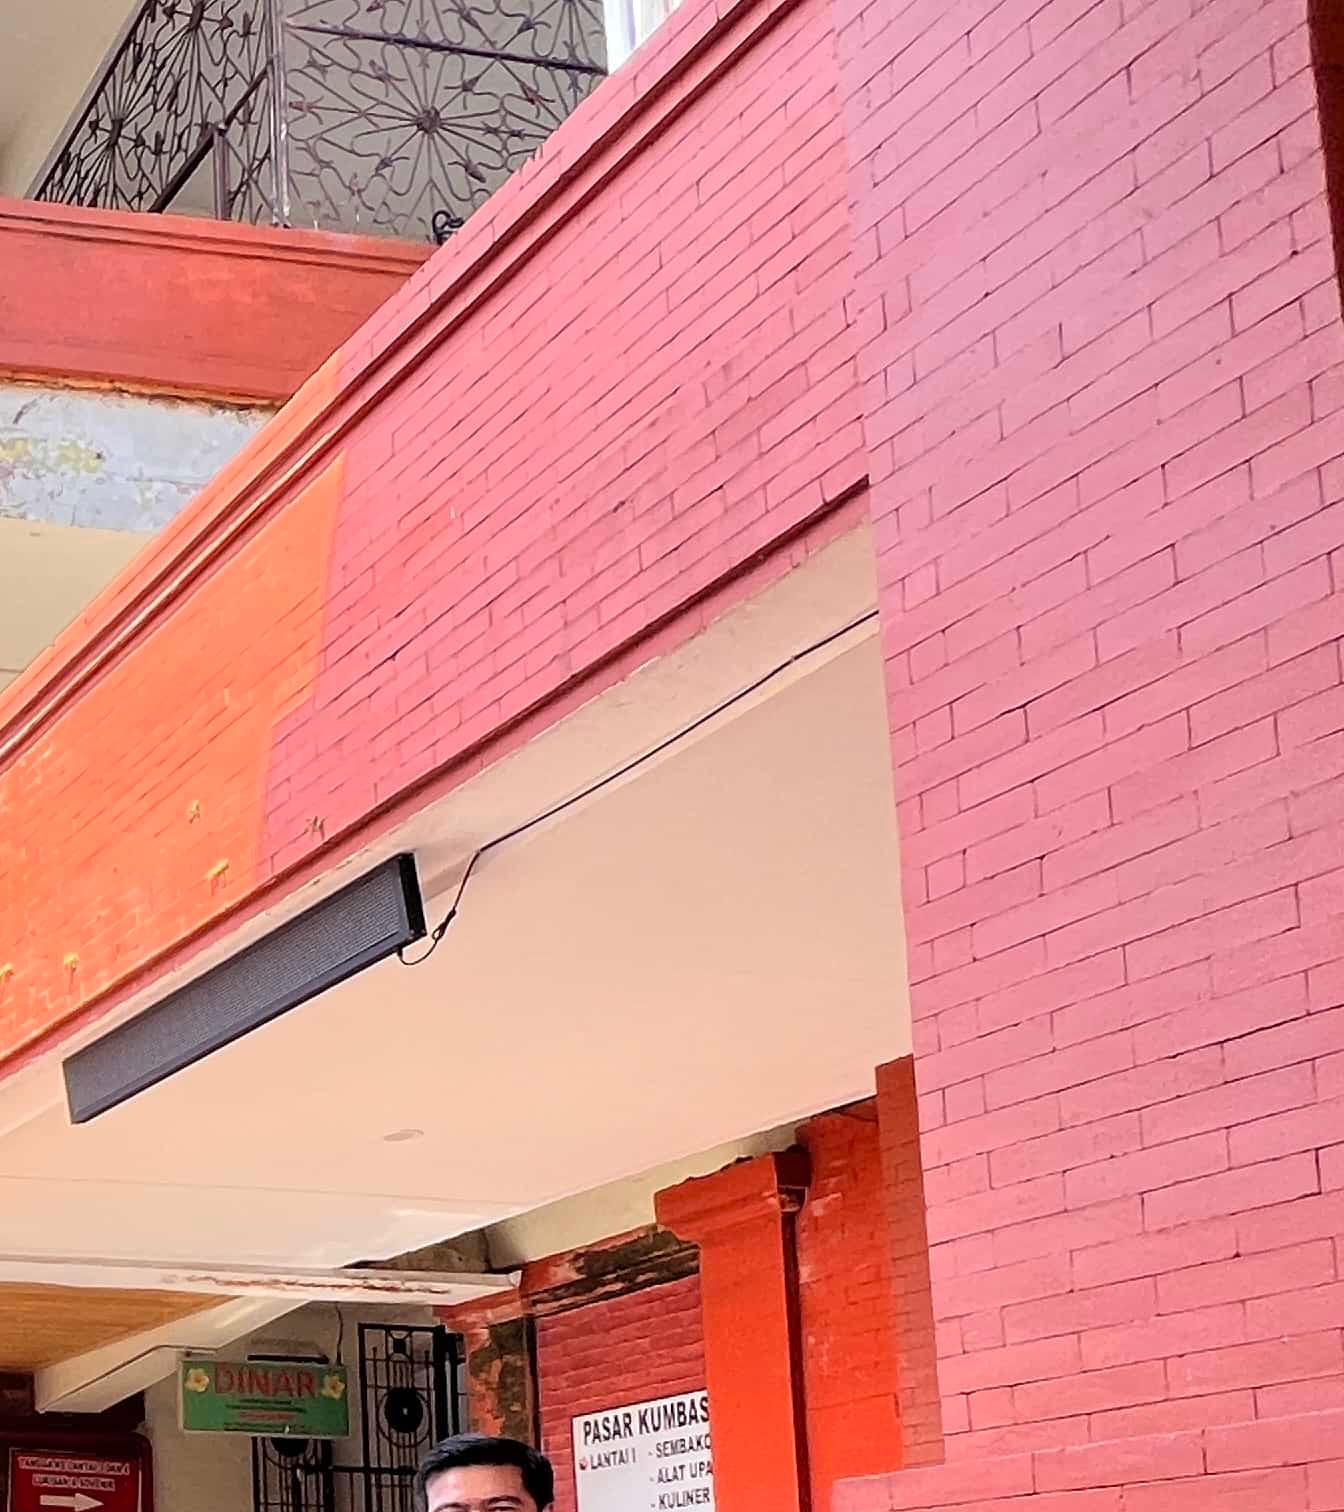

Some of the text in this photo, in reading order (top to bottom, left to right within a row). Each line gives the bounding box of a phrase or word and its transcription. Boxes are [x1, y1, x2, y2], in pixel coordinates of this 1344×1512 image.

[215, 1362, 318, 1398] DINAR
[583, 1396, 710, 1445] PASAR KUMBAS
[590, 1448, 629, 1469] LANTAI
[657, 1465, 686, 1484] ALAT
[658, 1487, 710, 1510] KULINER
